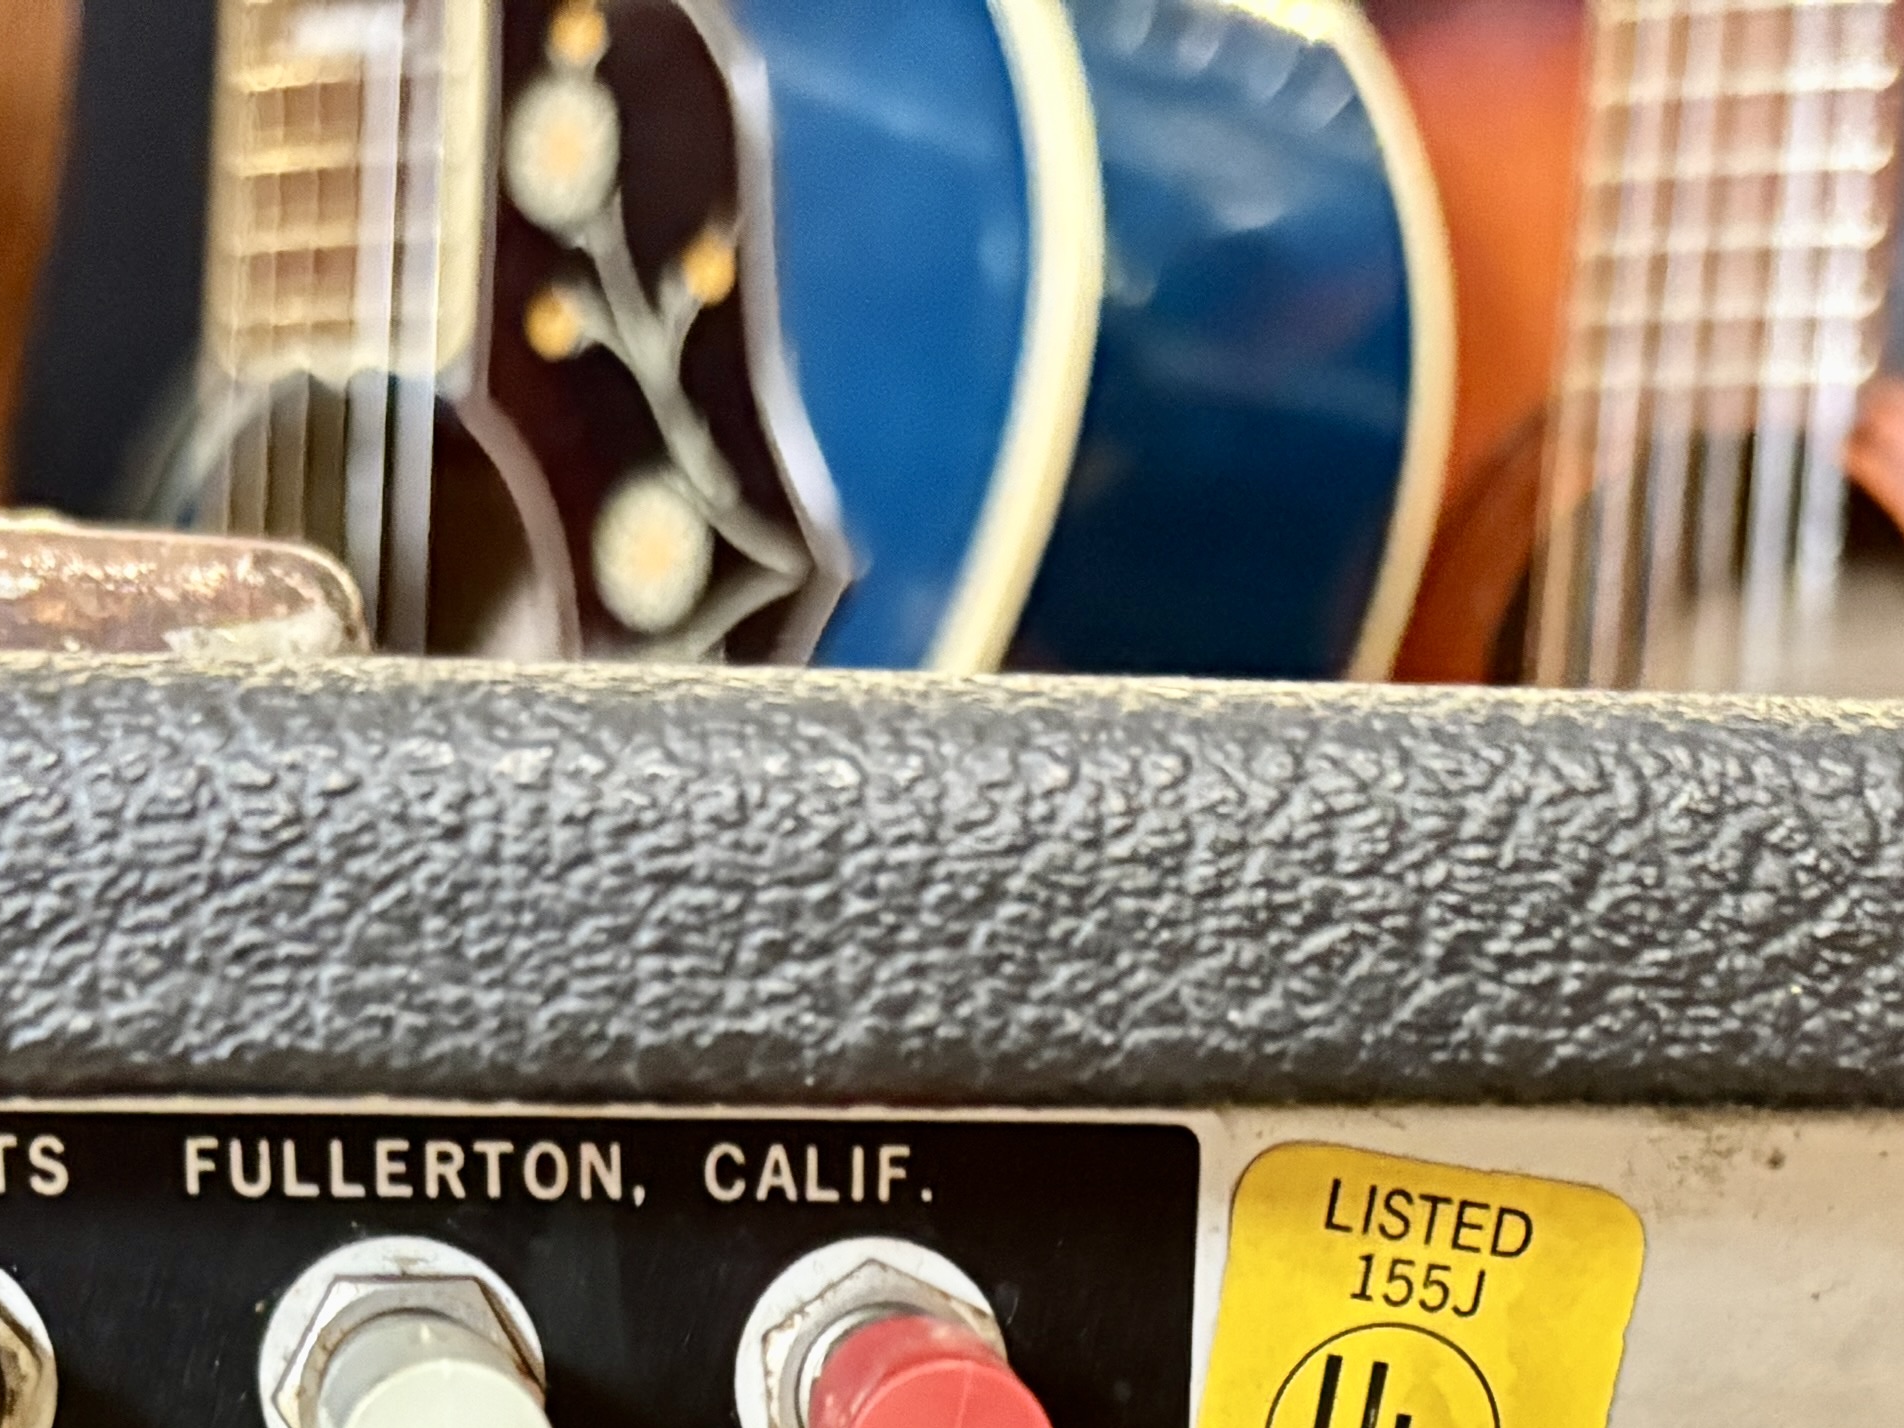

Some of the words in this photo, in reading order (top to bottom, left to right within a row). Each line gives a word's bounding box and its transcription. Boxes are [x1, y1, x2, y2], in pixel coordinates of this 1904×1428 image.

[185, 1137, 645, 1206] FULLERTON,
[704, 1143, 933, 1202] CALIF.
[1324, 1178, 1533, 1259] LISTED
[1350, 1253, 1486, 1318] 155J
